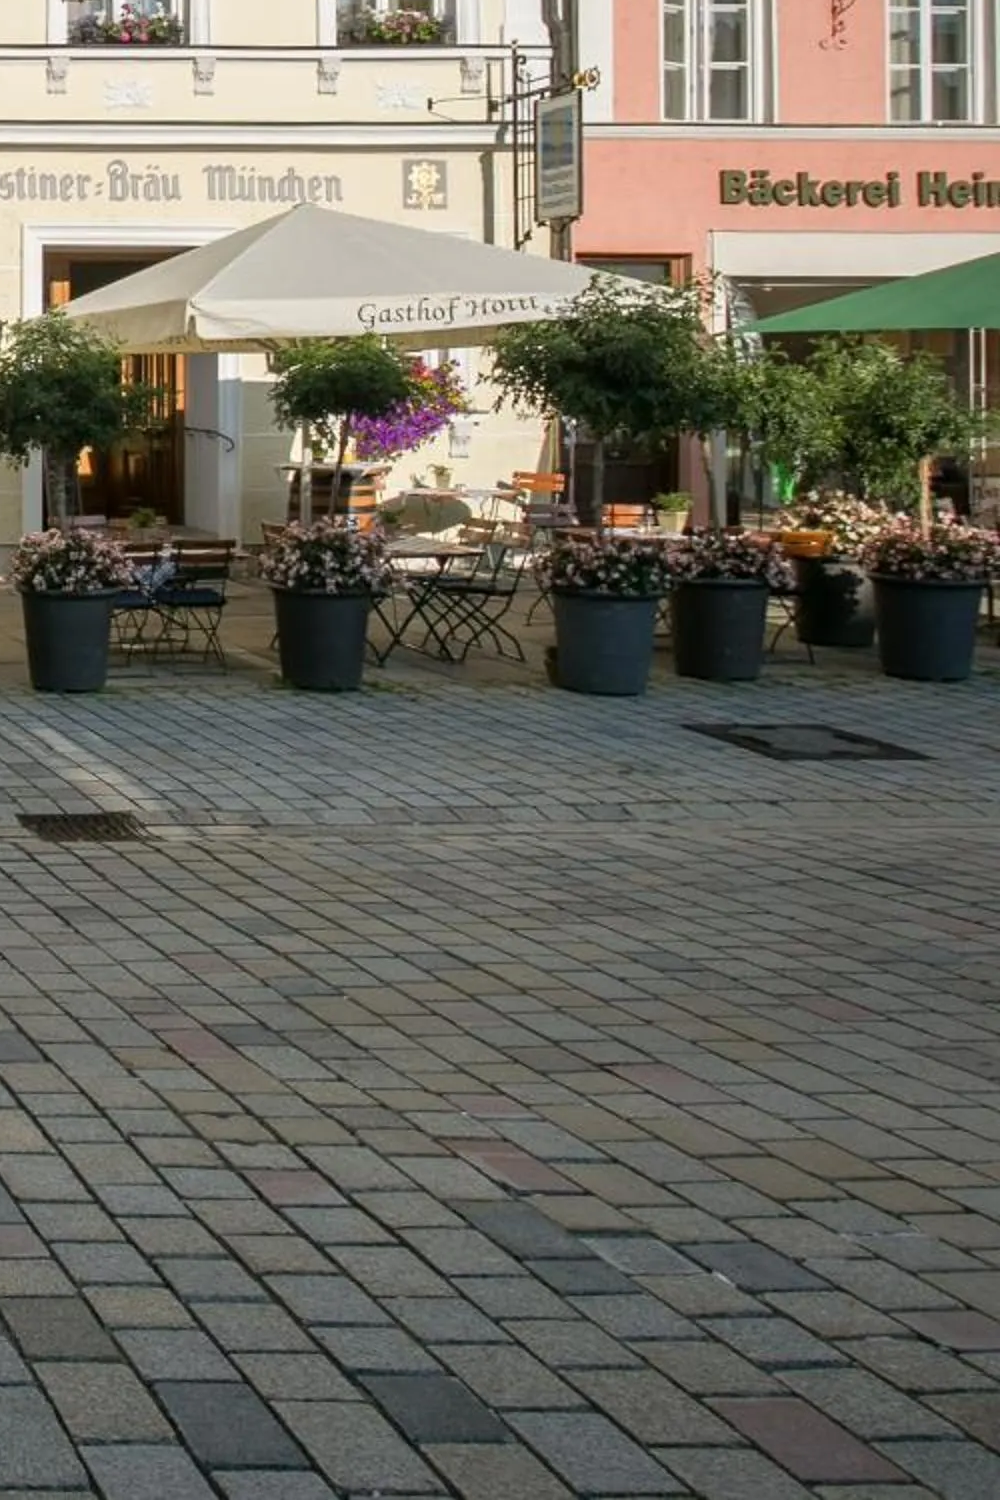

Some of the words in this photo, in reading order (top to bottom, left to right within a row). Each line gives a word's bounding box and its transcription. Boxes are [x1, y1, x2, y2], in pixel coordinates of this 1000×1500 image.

[202, 164, 343, 202] München
[719, 170, 900, 208] Bäckerei
[357, 296, 460, 330] Gasthof
